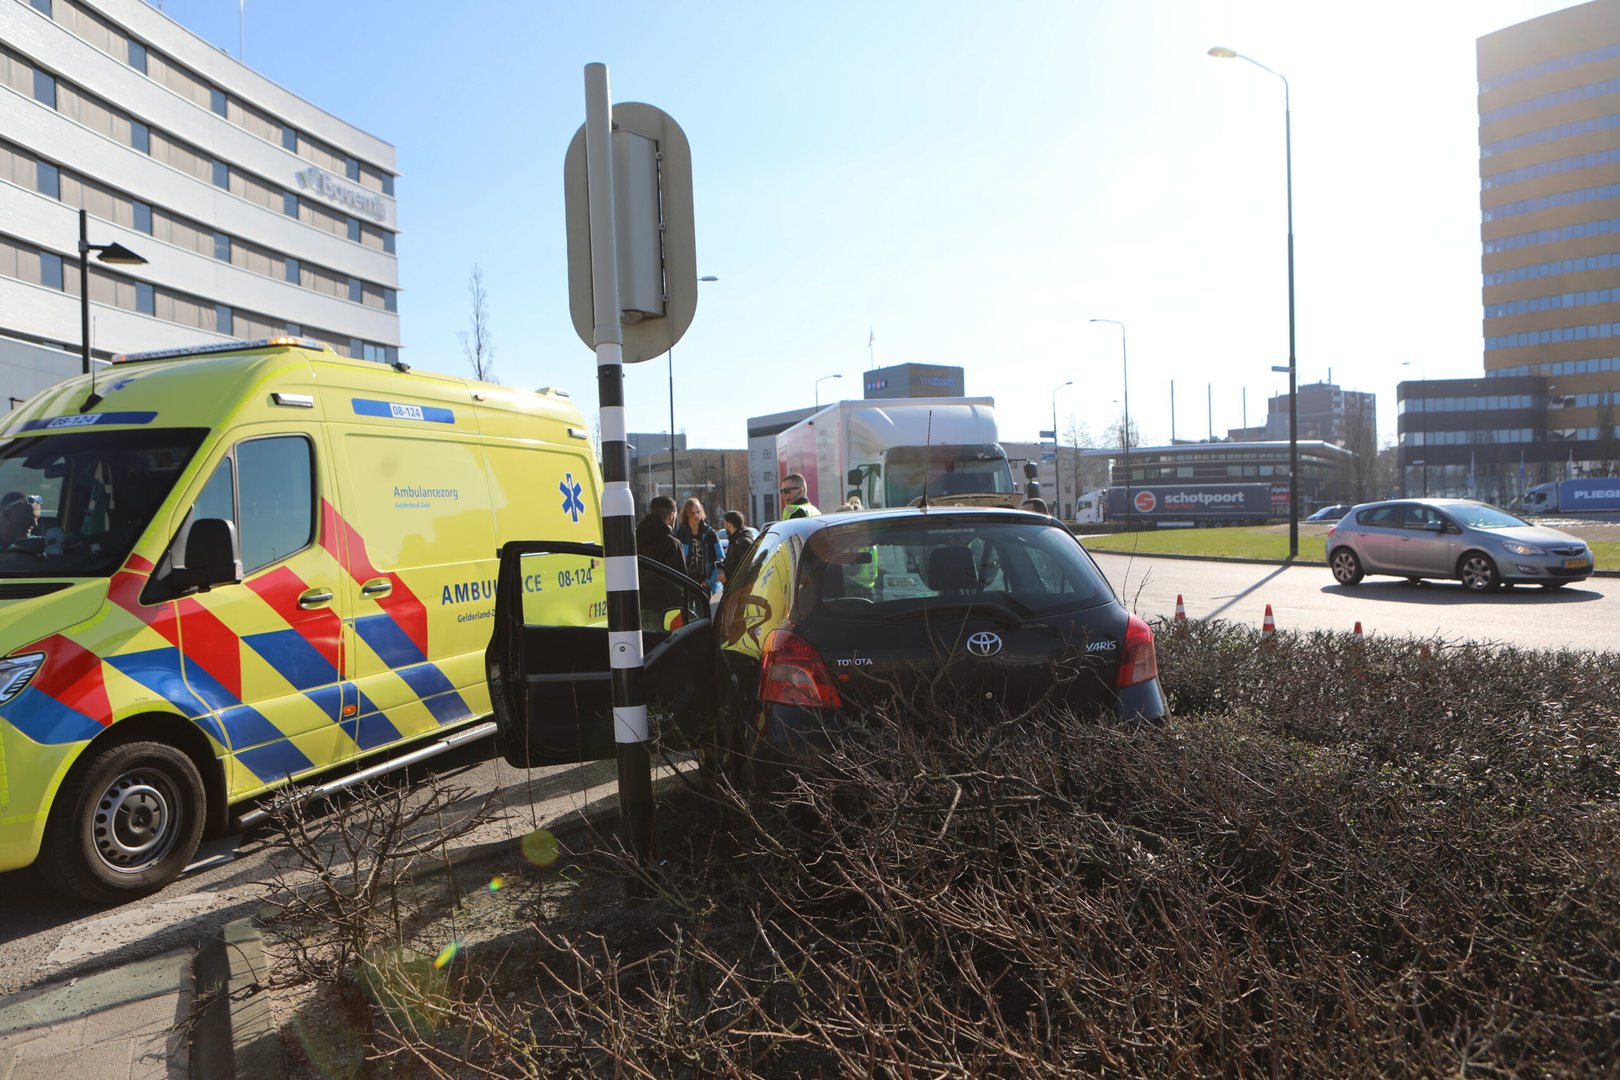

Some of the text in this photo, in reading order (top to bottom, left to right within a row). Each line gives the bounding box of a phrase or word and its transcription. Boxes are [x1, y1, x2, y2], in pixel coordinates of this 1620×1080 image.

[392, 405, 421, 418] 08-124
[51, 415, 96, 426] 08-124
[393, 485, 459, 501] Ambulancezorg
[1164, 491, 1245, 506] schotpoort
[441, 567, 593, 606] AMBUCE 08-124
[457, 608, 496, 623] Gelderland-Z
[1085, 640, 1117, 653] YARIS
